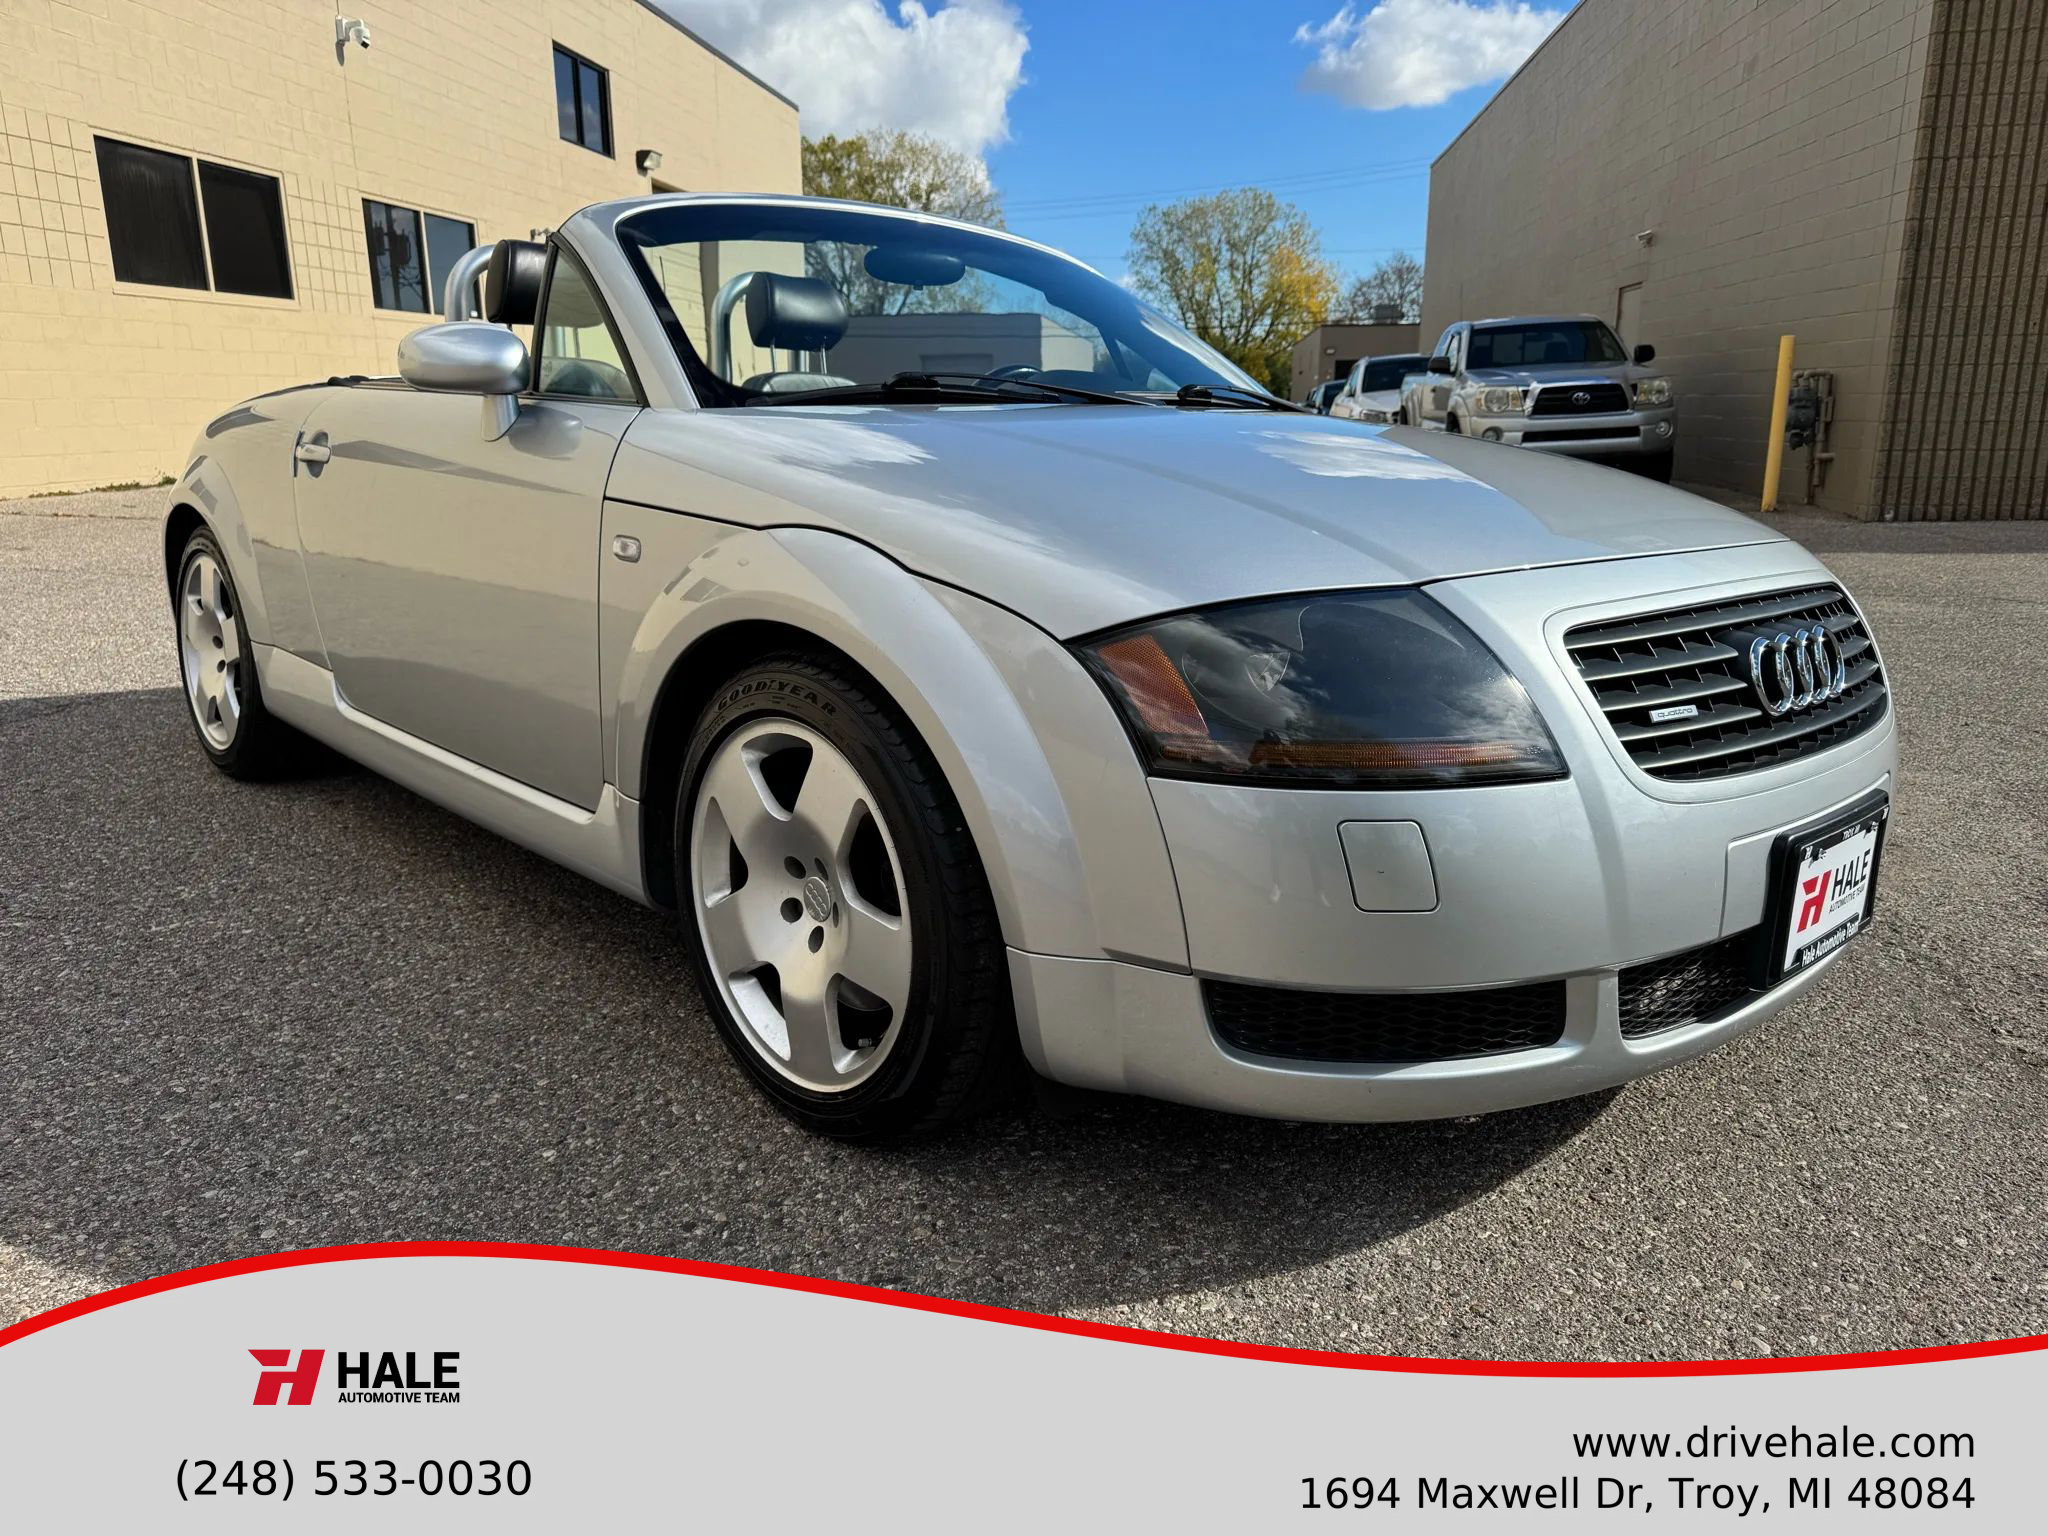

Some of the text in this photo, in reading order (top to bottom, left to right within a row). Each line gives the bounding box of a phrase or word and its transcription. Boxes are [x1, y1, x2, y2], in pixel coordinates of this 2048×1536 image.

[716, 679, 837, 717] GOODYEAR
[1657, 708, 1693, 718] quattro
[1831, 848, 1871, 901] HALE
[1801, 921, 1860, 967] Hale Automotive Team
